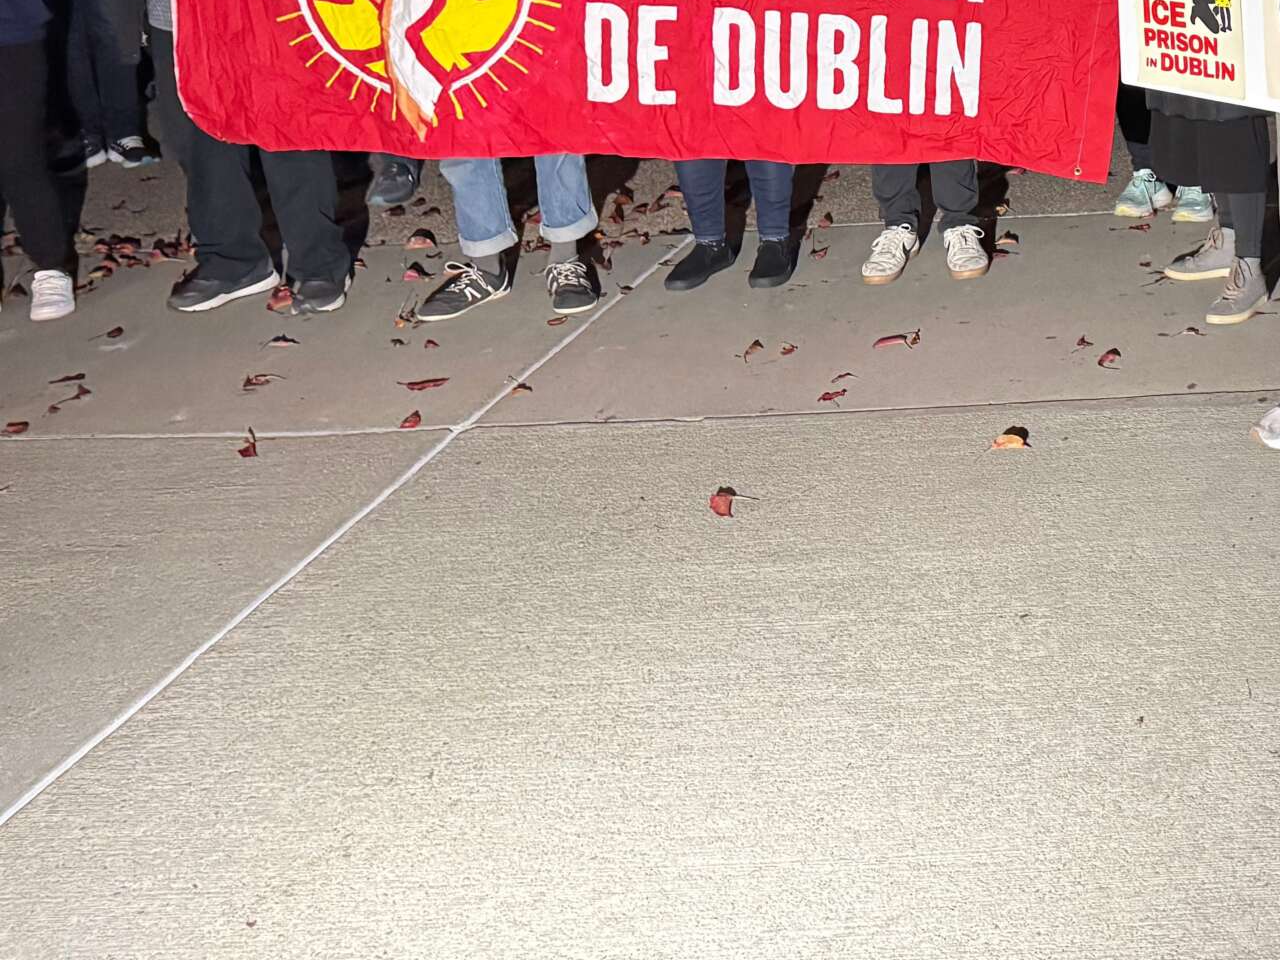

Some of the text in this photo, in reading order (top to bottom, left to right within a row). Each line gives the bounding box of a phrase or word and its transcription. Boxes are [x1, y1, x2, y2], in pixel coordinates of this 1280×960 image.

[1144, 27, 1219, 56] PRISON
[583, 1, 982, 118] DE DUBLIN
[1146, 52, 1235, 82] IN DUBLIN
